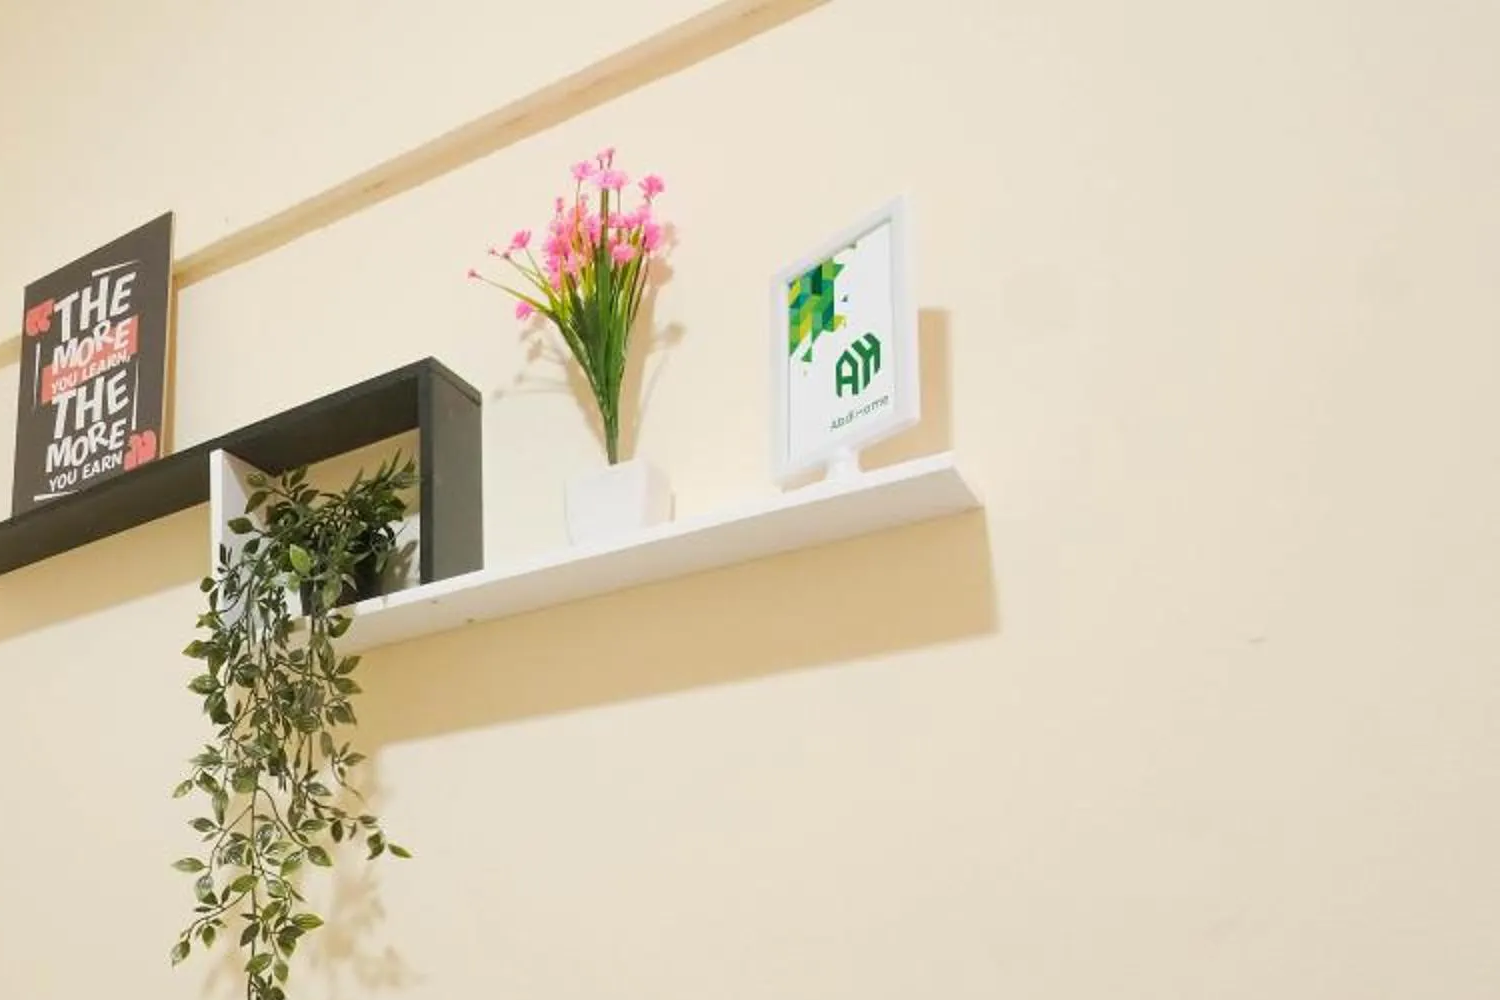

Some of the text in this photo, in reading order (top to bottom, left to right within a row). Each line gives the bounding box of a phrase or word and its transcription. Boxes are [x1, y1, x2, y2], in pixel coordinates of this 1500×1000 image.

[53, 271, 136, 342] THE
[52, 318, 132, 376] MORE
[51, 373, 77, 395] YOU
[52, 369, 130, 439] THE
[45, 418, 127, 473] MORE
[49, 451, 123, 492] YOU EARN
